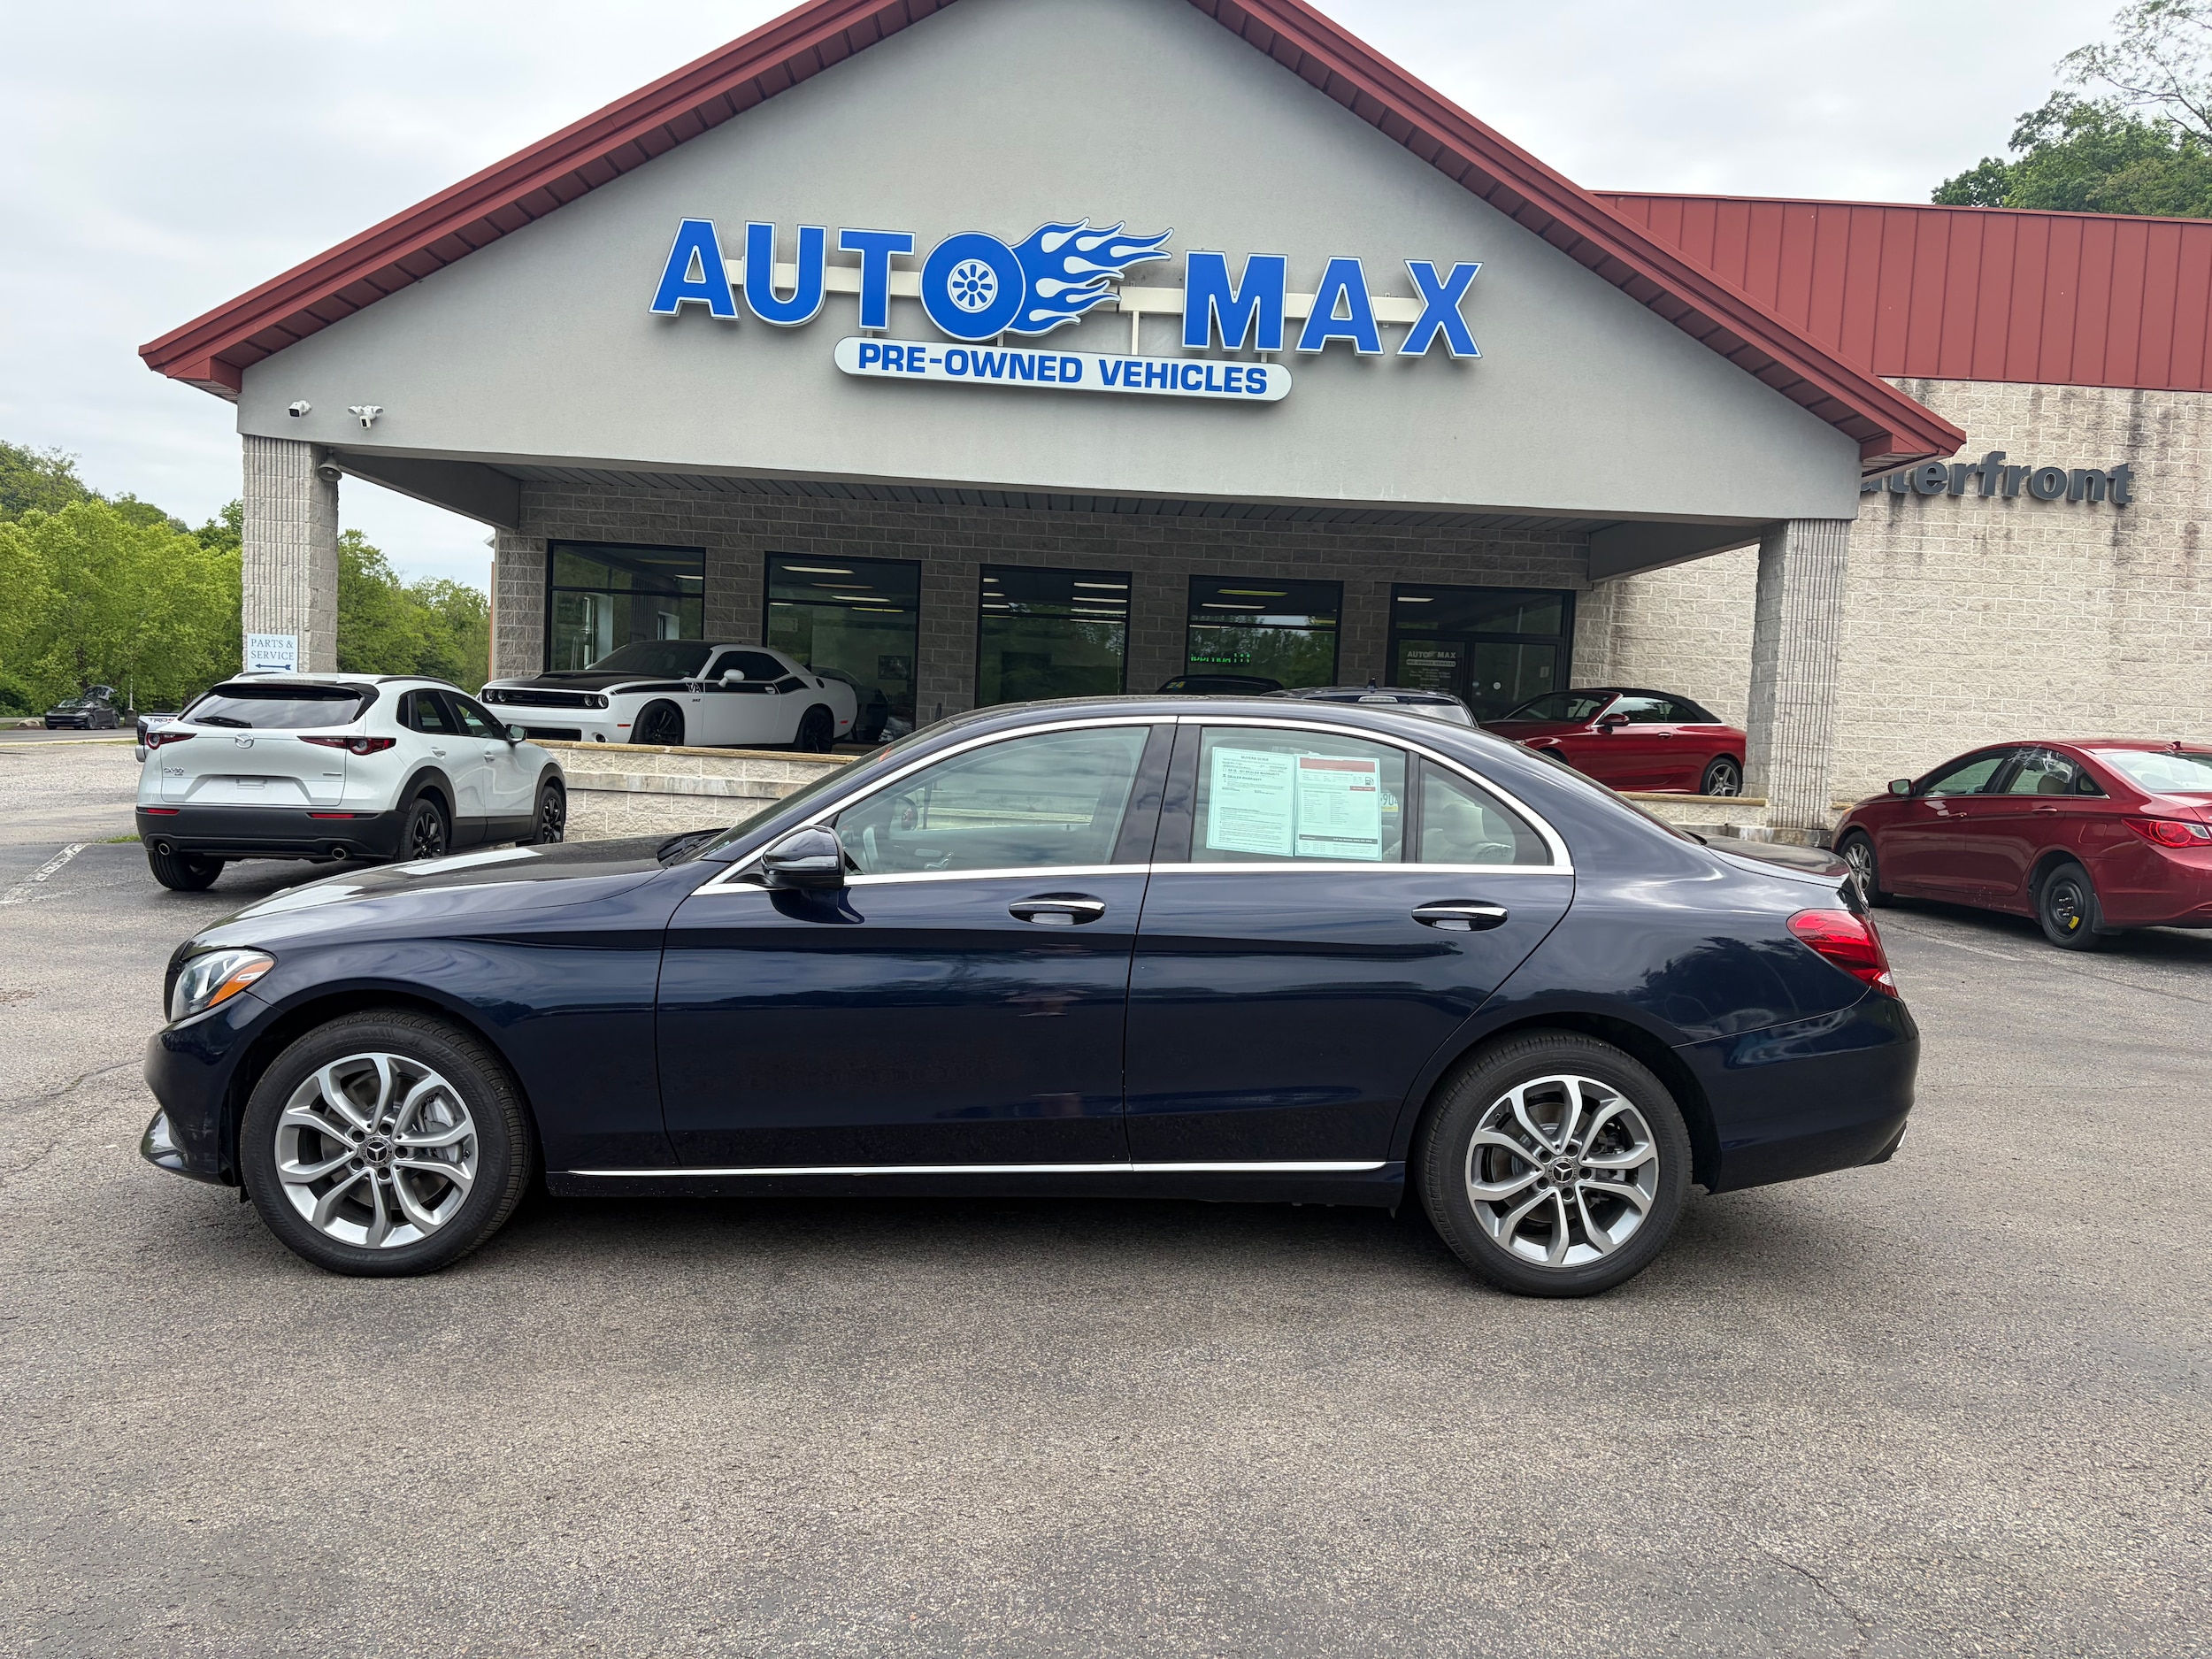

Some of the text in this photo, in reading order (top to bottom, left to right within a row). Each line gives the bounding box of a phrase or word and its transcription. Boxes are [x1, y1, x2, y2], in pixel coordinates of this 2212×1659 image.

[649, 217, 1484, 360] AUTO MAX
[856, 346, 1269, 395] PRE-OWNED VEHICLES
[250, 638, 294, 649] PARTS &
[250, 650, 295, 661] SERVICE
